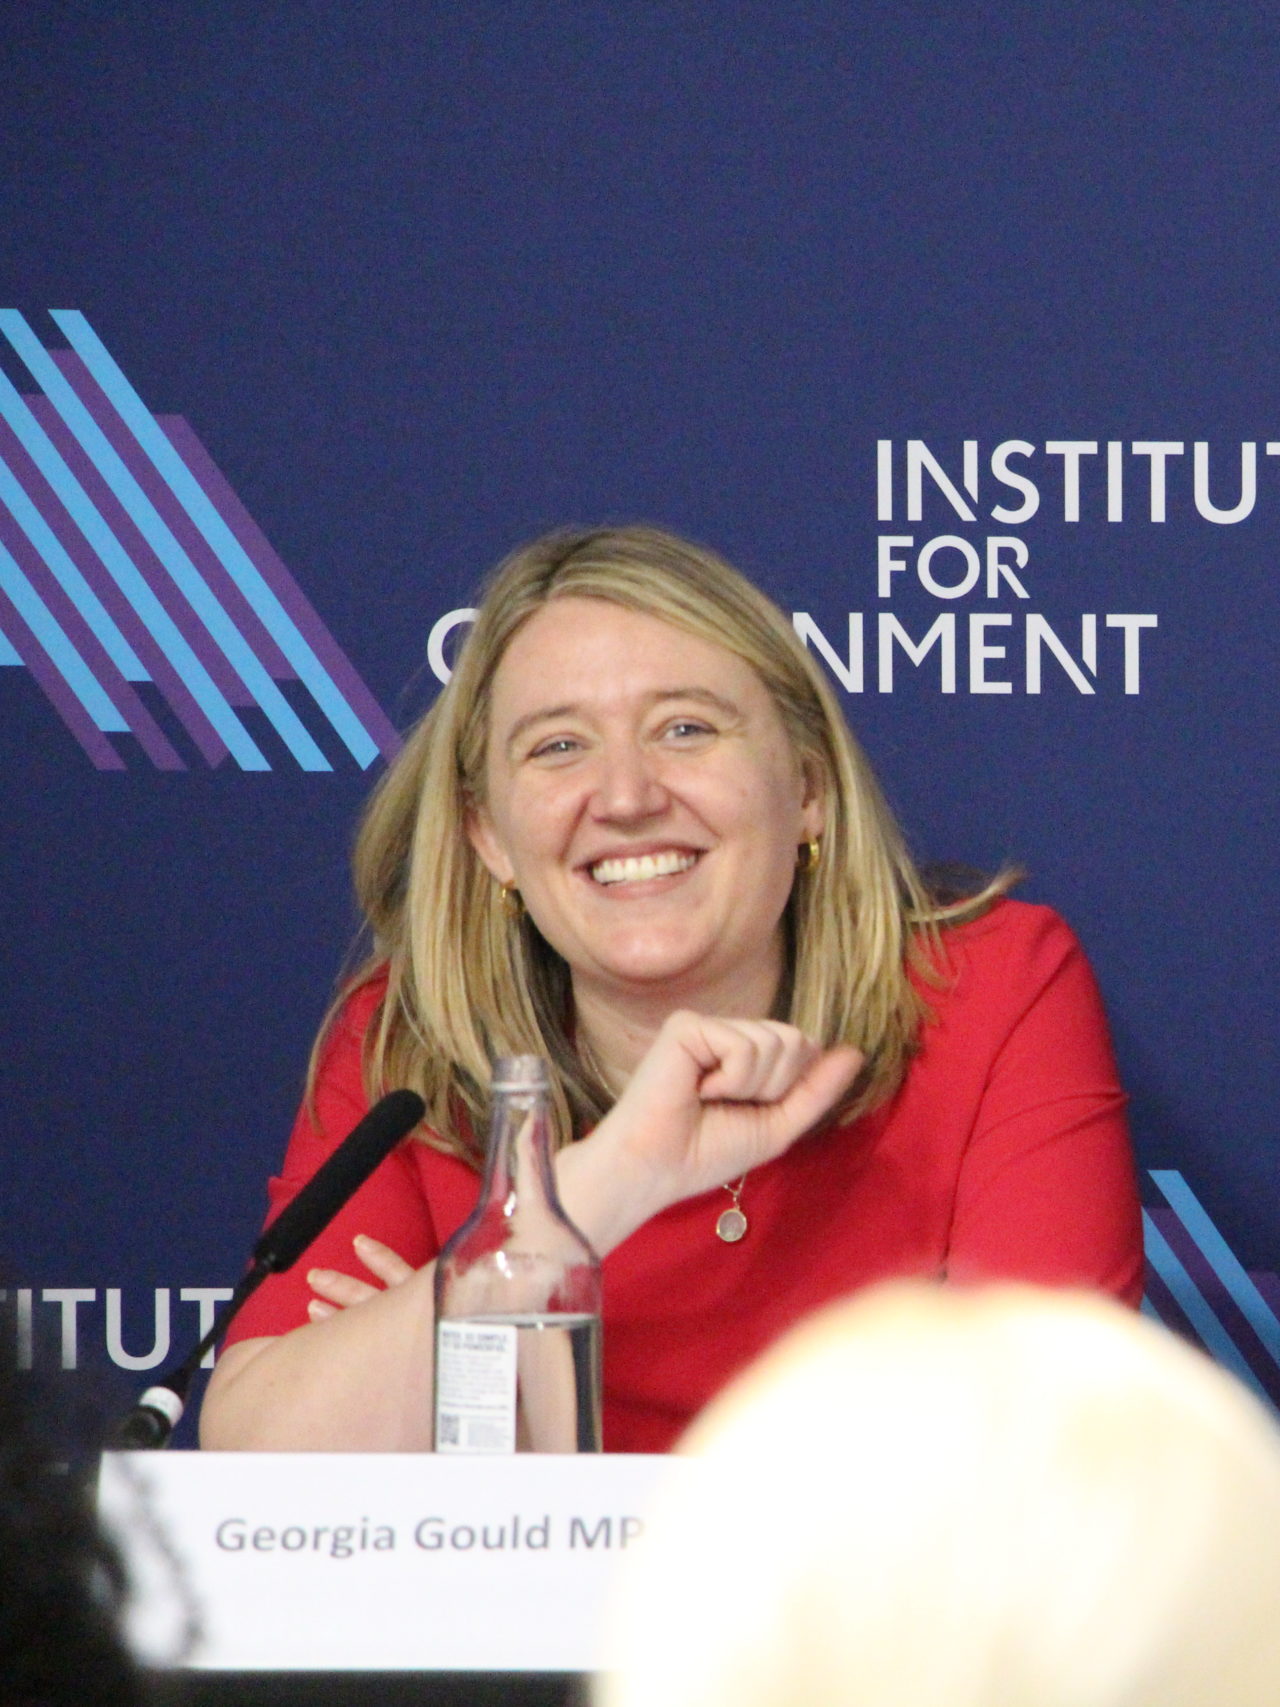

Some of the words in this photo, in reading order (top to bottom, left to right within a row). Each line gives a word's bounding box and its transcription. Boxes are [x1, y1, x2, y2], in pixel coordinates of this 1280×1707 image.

[877, 535, 1031, 600] FOR
[215, 1516, 396, 1559] Georgia
[414, 1515, 551, 1551] Gould
[569, 1517, 646, 1550] MP
